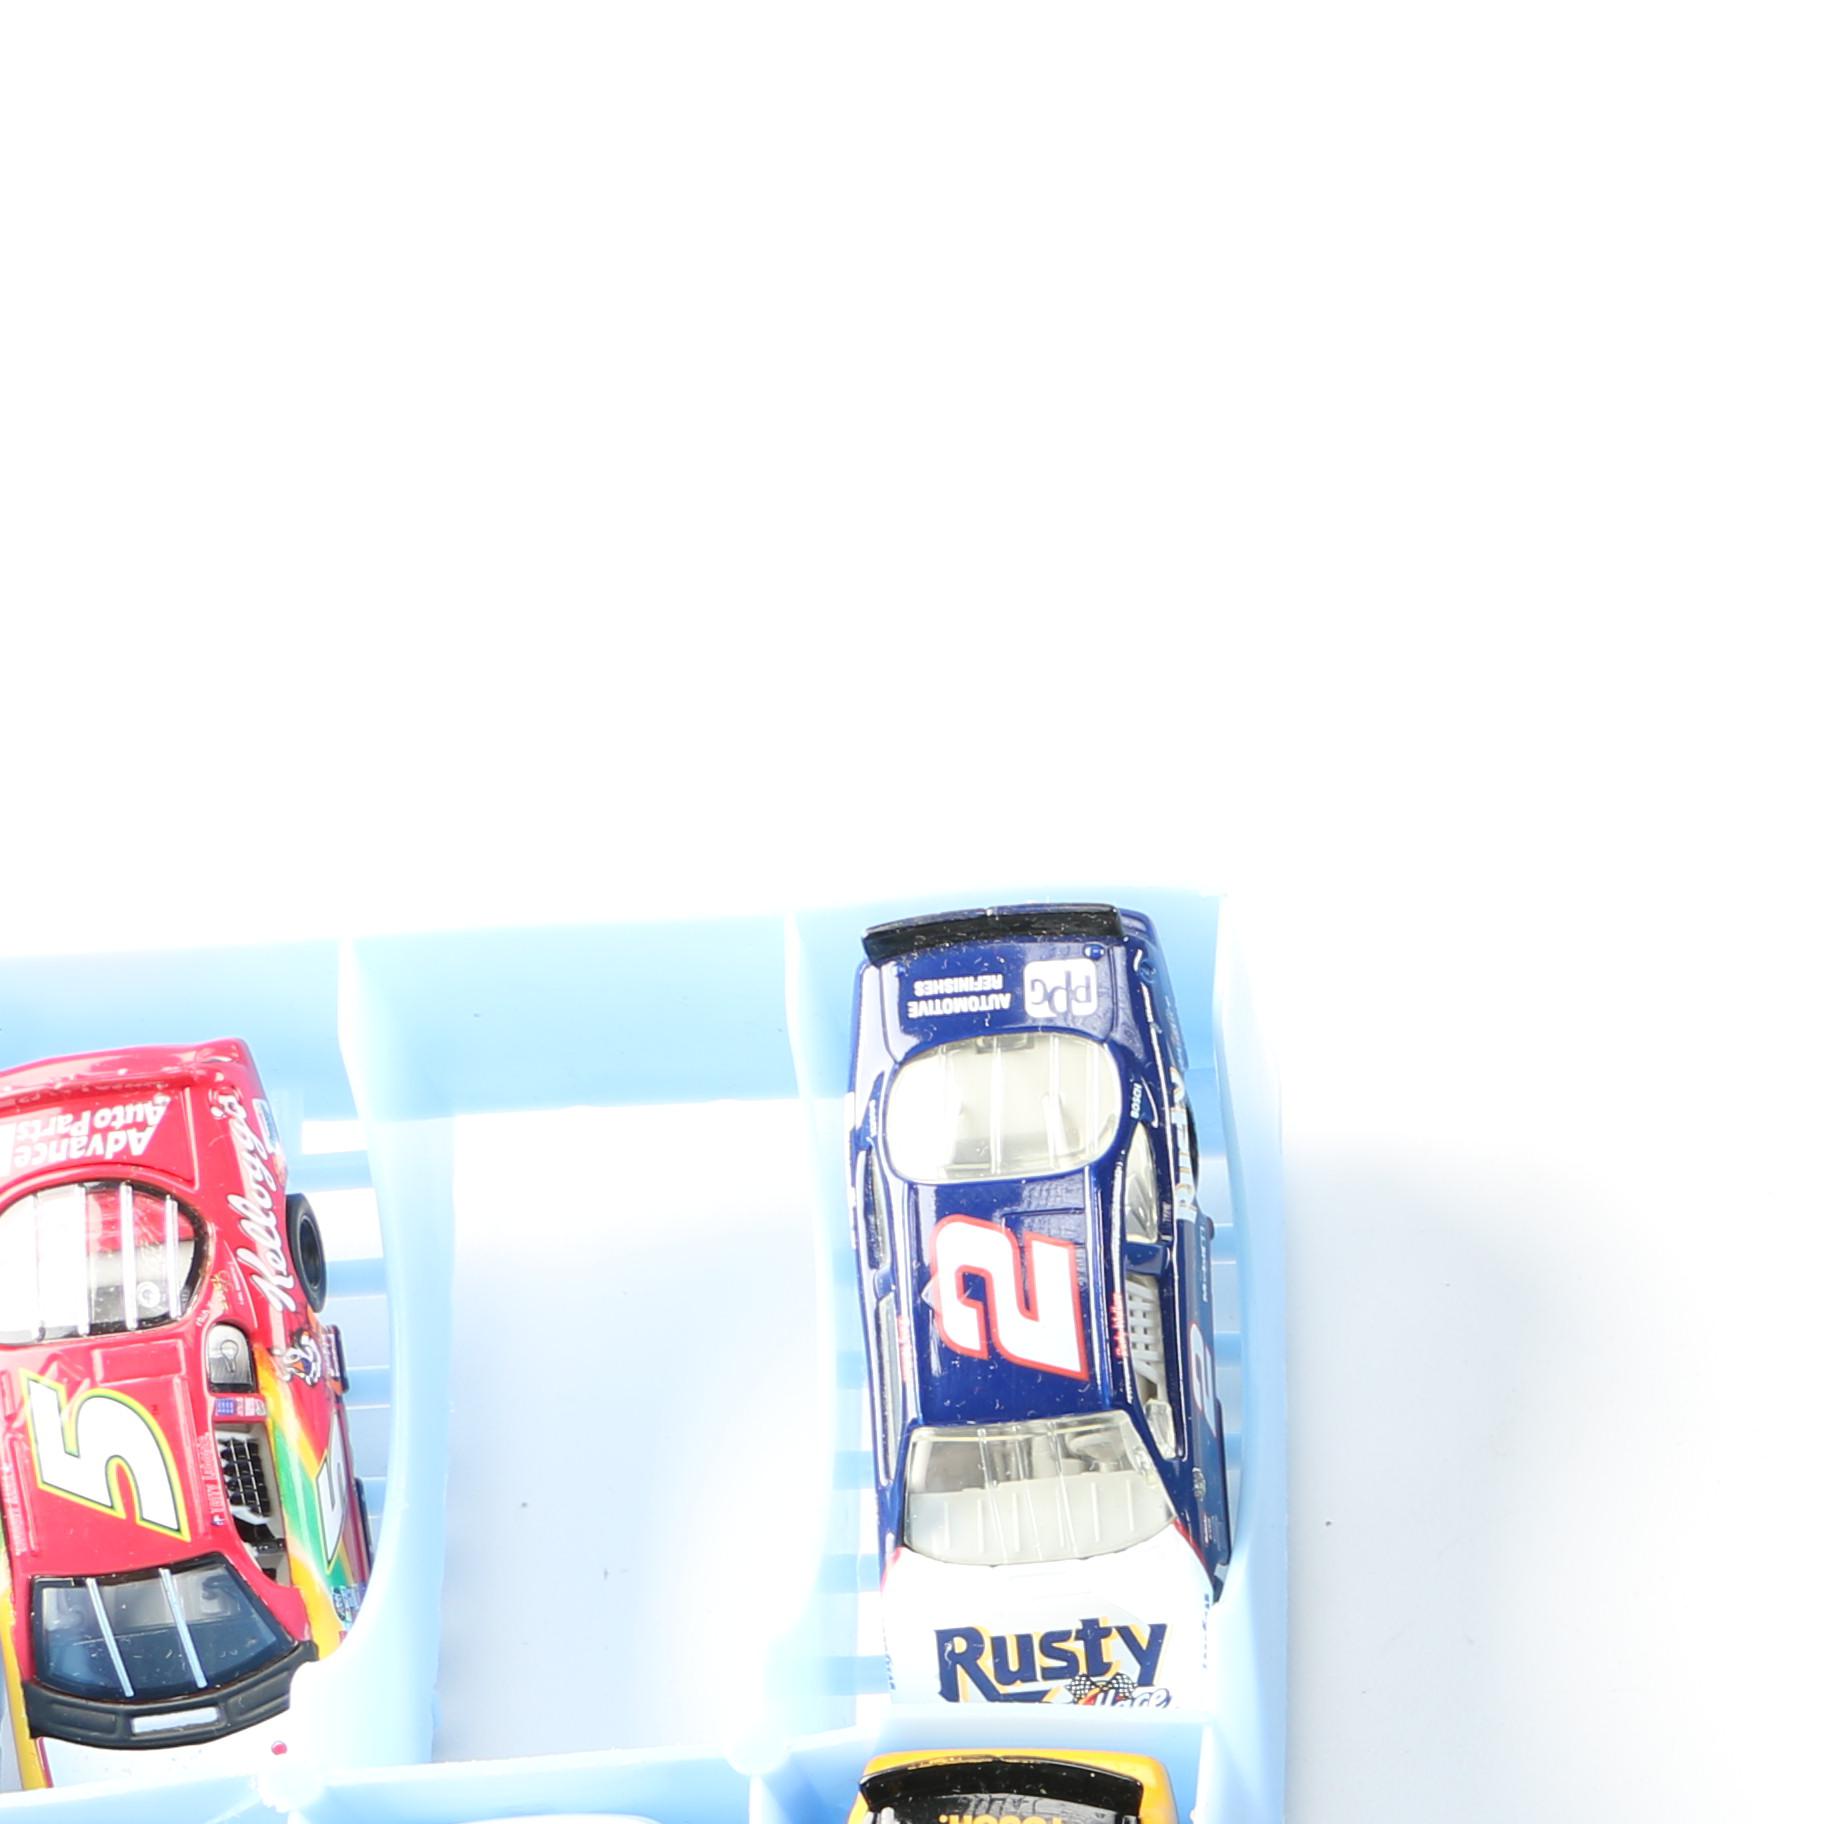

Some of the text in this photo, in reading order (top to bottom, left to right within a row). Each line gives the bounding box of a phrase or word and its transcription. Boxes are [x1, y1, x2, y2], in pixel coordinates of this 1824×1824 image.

[907, 992, 1011, 1018] AUTOMOTIVE
[913, 974, 1004, 997] REFINISHES
[15, 1095, 172, 1139] Auto Parts
[1129, 1082, 1143, 1119] BOSCH
[14, 1126, 154, 1169] Advance
[931, 1213, 1089, 1381] 2
[20, 1368, 190, 1541] 5
[934, 1619, 1171, 1703] Rusty
